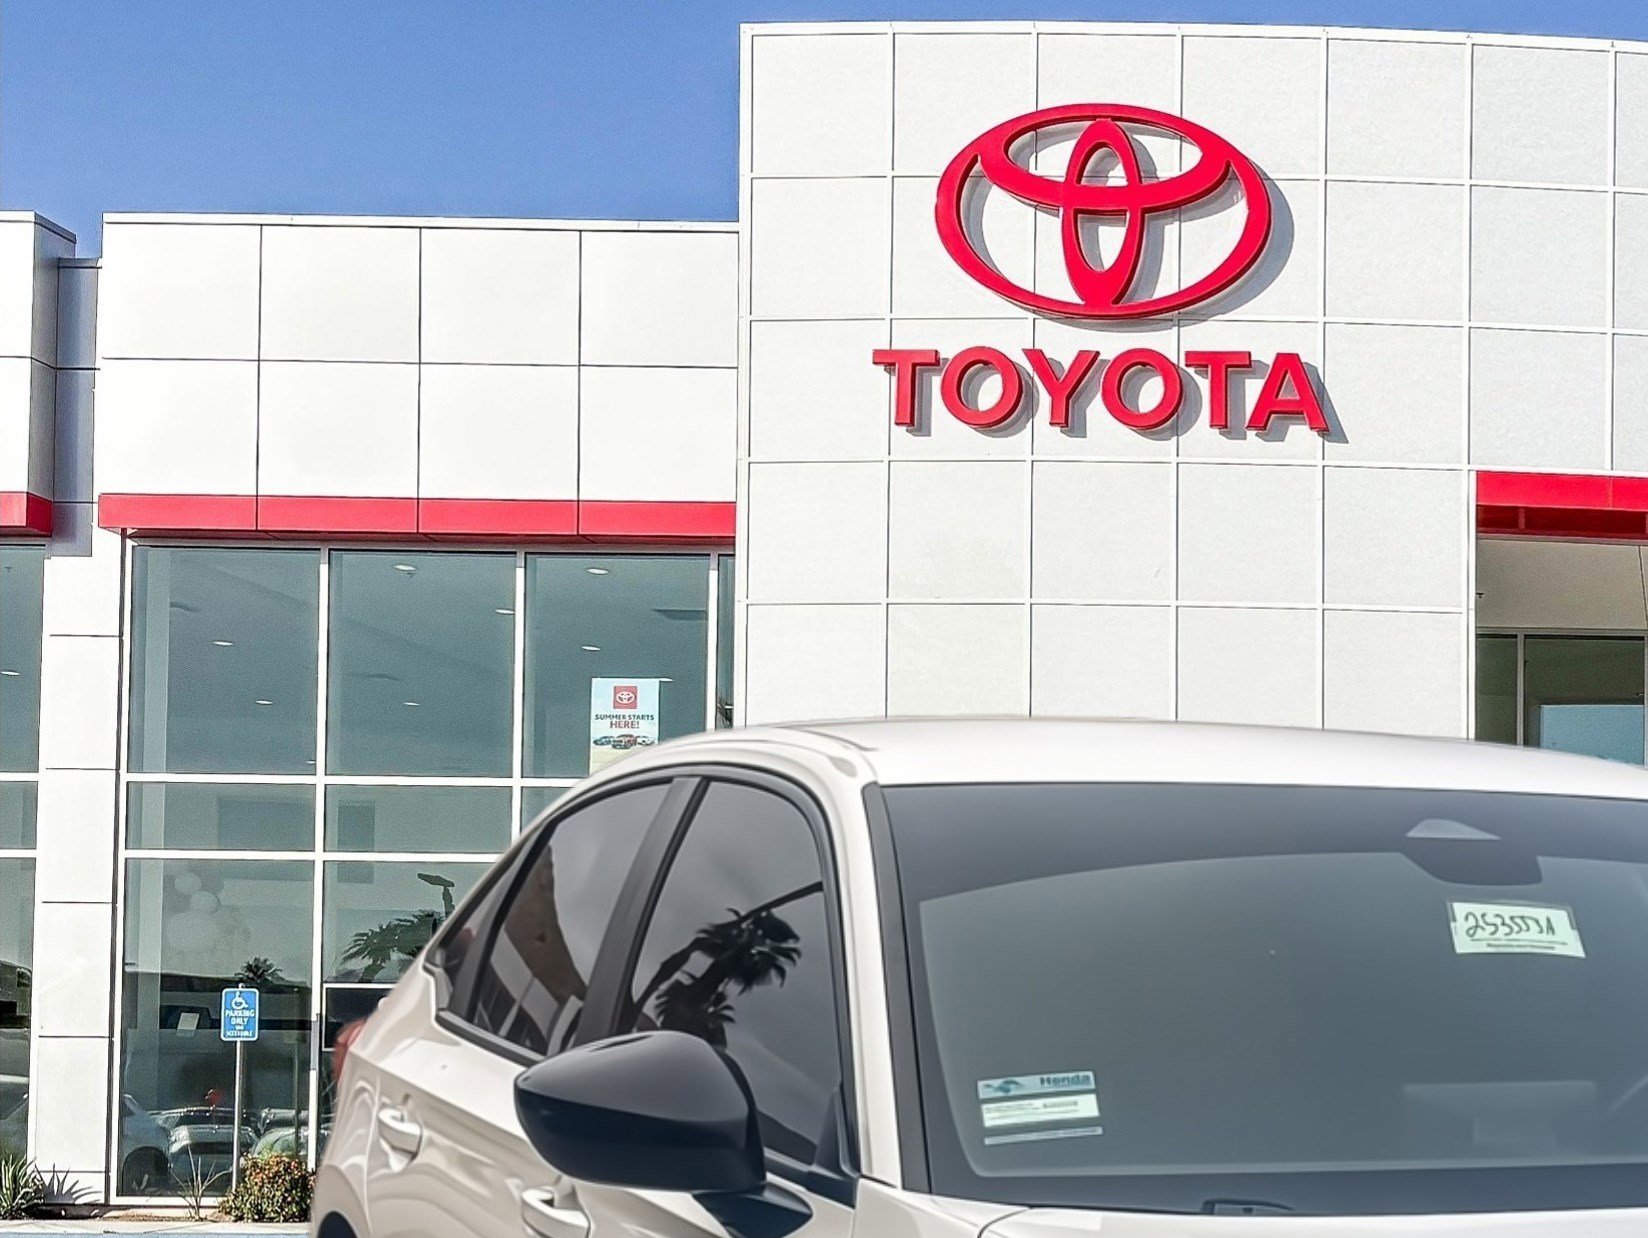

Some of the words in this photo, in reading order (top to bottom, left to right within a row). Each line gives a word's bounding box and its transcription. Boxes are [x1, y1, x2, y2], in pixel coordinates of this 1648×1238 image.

[873, 346, 1330, 434] TOYOTA
[610, 721, 640, 729] HERE!
[1040, 1073, 1091, 1086] Honda
